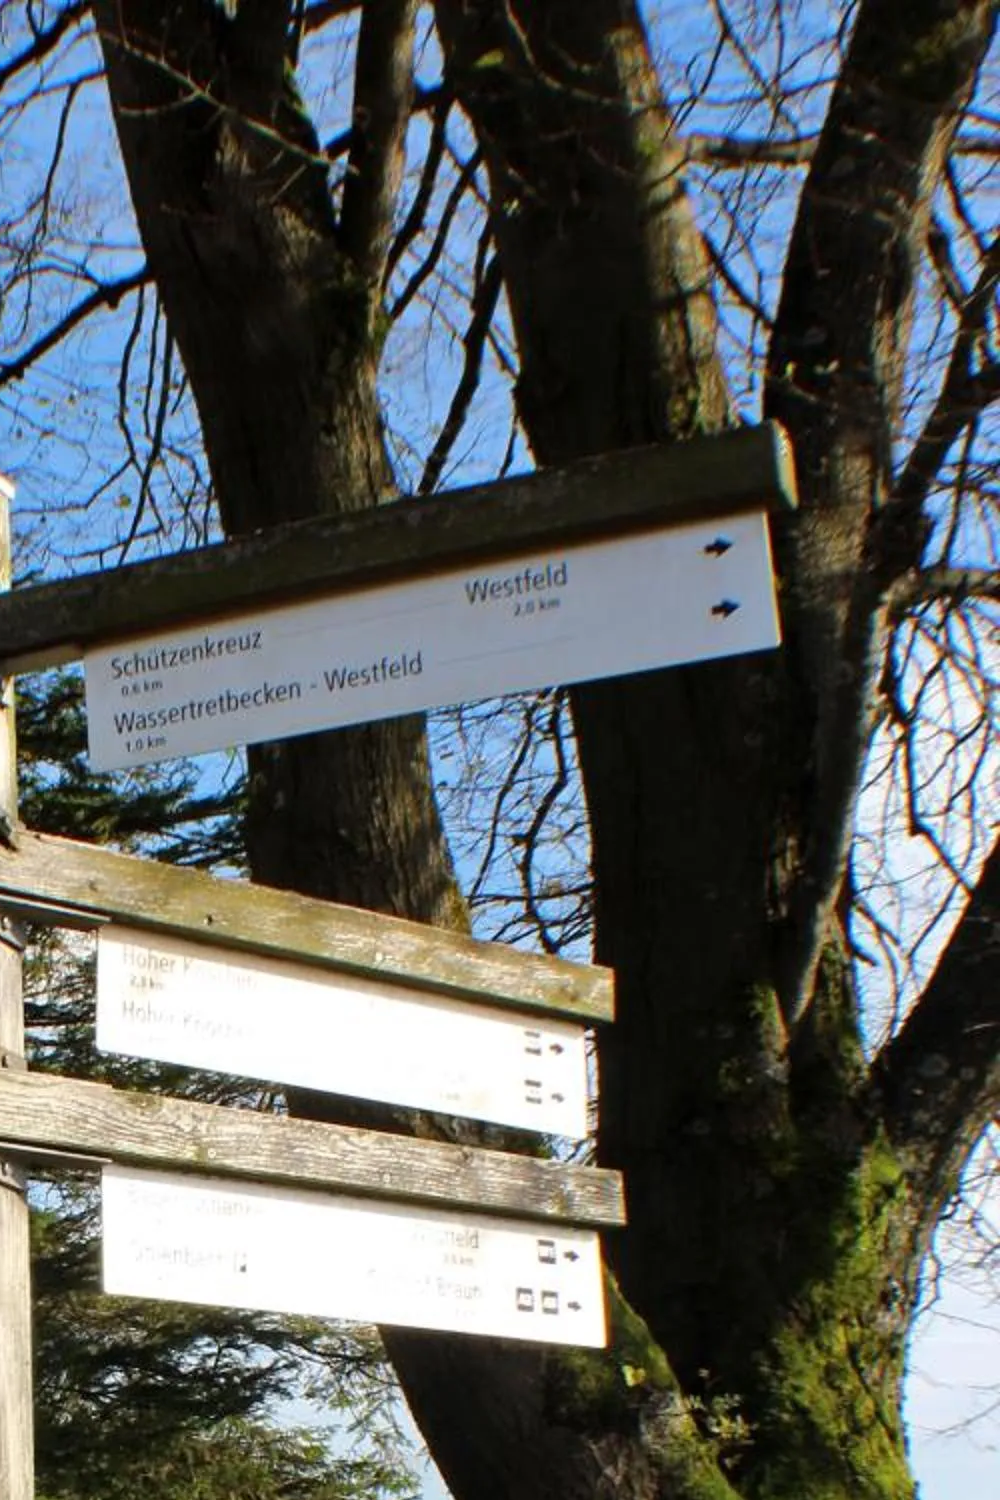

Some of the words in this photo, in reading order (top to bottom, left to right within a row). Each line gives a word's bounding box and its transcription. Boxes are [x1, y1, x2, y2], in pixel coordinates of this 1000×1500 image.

[464, 562, 568, 605] Westfeld
[111, 631, 262, 680] Schützenkreuz
[114, 679, 301, 734] Wassertretbecken
[324, 651, 423, 693] Westfeld
[143, 679, 163, 692] km
[148, 735, 167, 748] km
